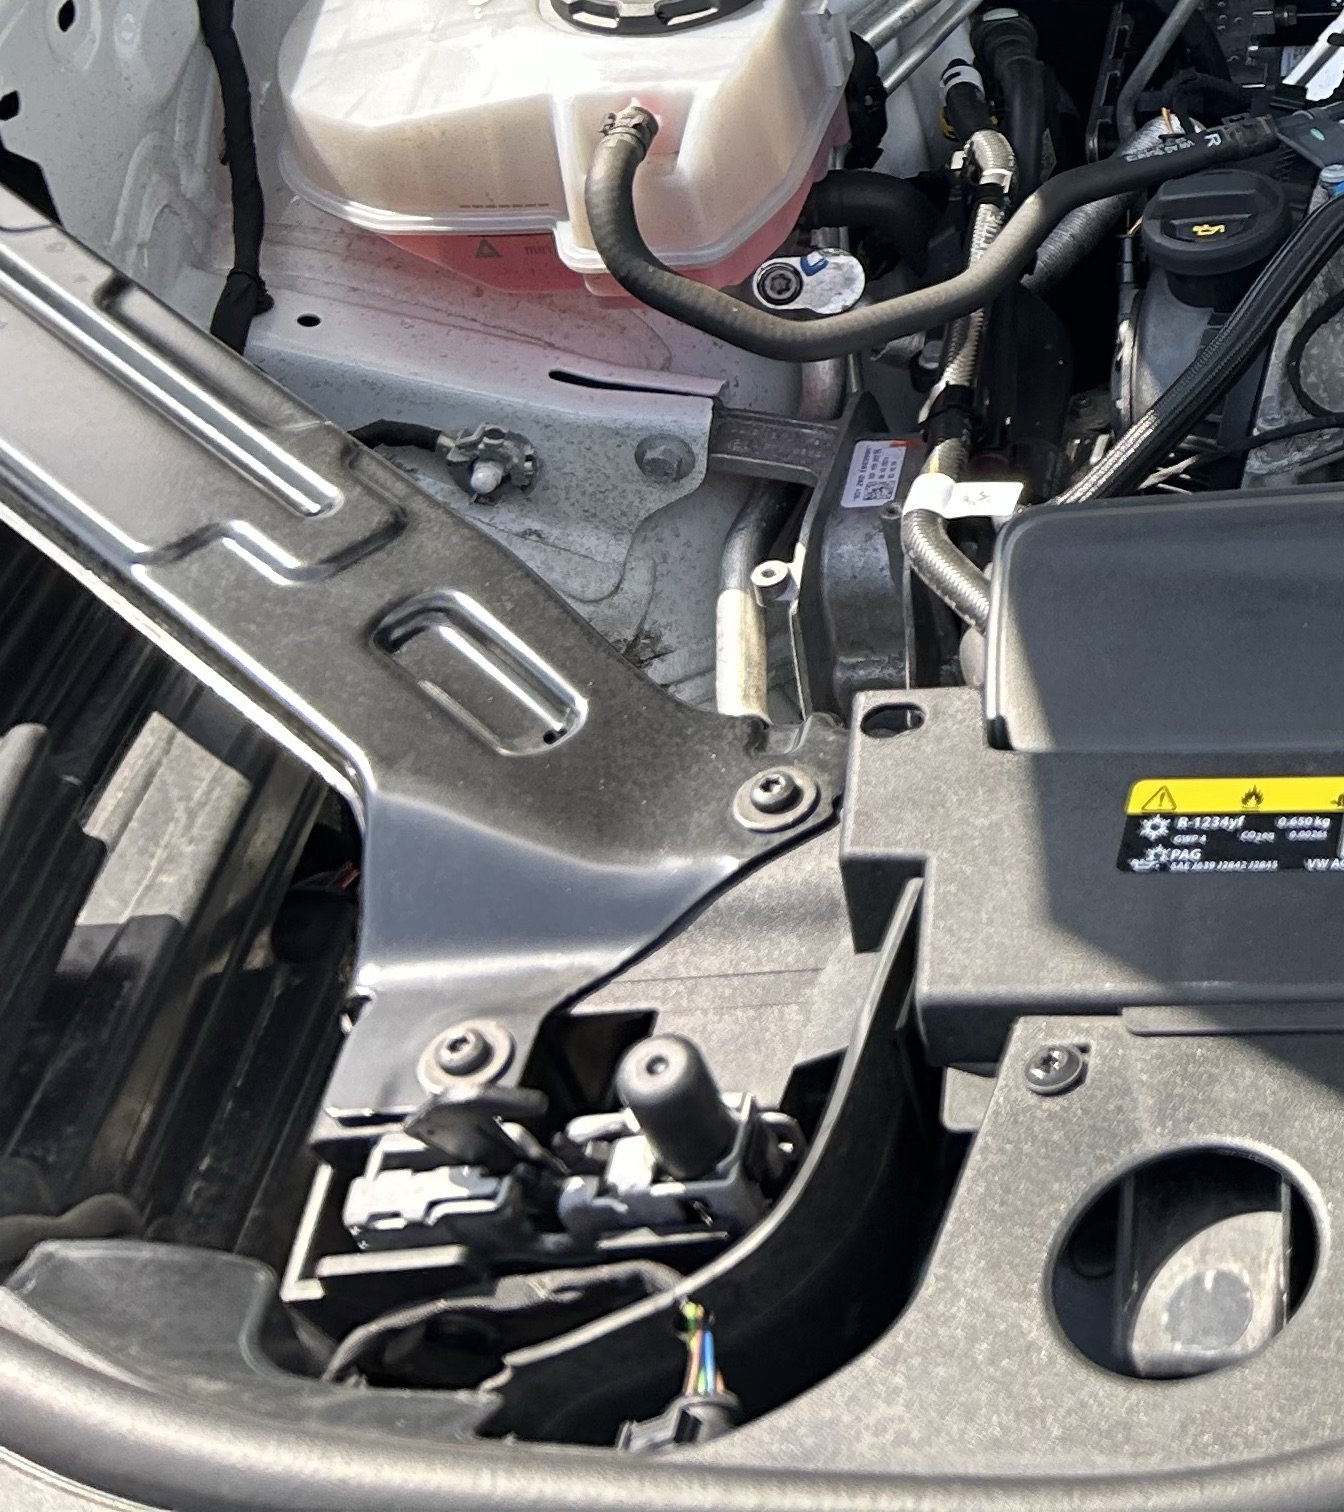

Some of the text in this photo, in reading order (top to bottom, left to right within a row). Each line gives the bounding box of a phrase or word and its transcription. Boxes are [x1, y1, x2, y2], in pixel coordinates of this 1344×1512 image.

[1315, 817, 1331, 830] kg
[1170, 849, 1202, 859] PAG
[1304, 858, 1331, 870] VW
